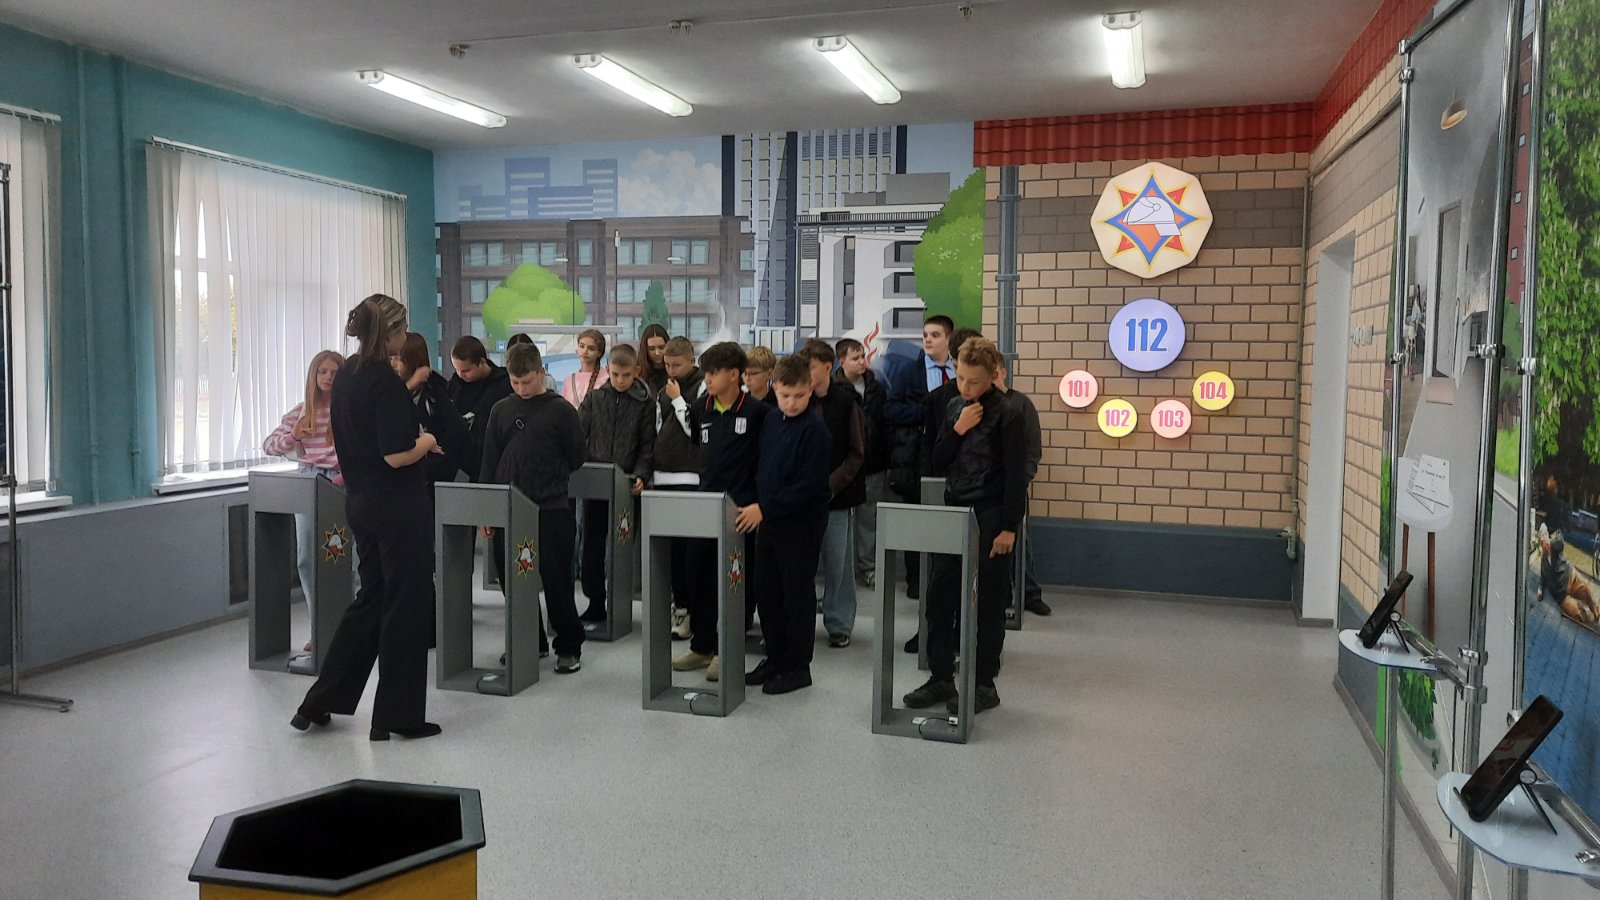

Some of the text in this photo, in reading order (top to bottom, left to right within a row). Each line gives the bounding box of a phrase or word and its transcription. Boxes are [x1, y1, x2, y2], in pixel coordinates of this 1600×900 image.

[1126, 318, 1168, 352] 112
[1068, 380, 1089, 397] 101
[1200, 382, 1227, 399] 104
[1105, 409, 1130, 427] 102
[1158, 410, 1184, 428] 103
